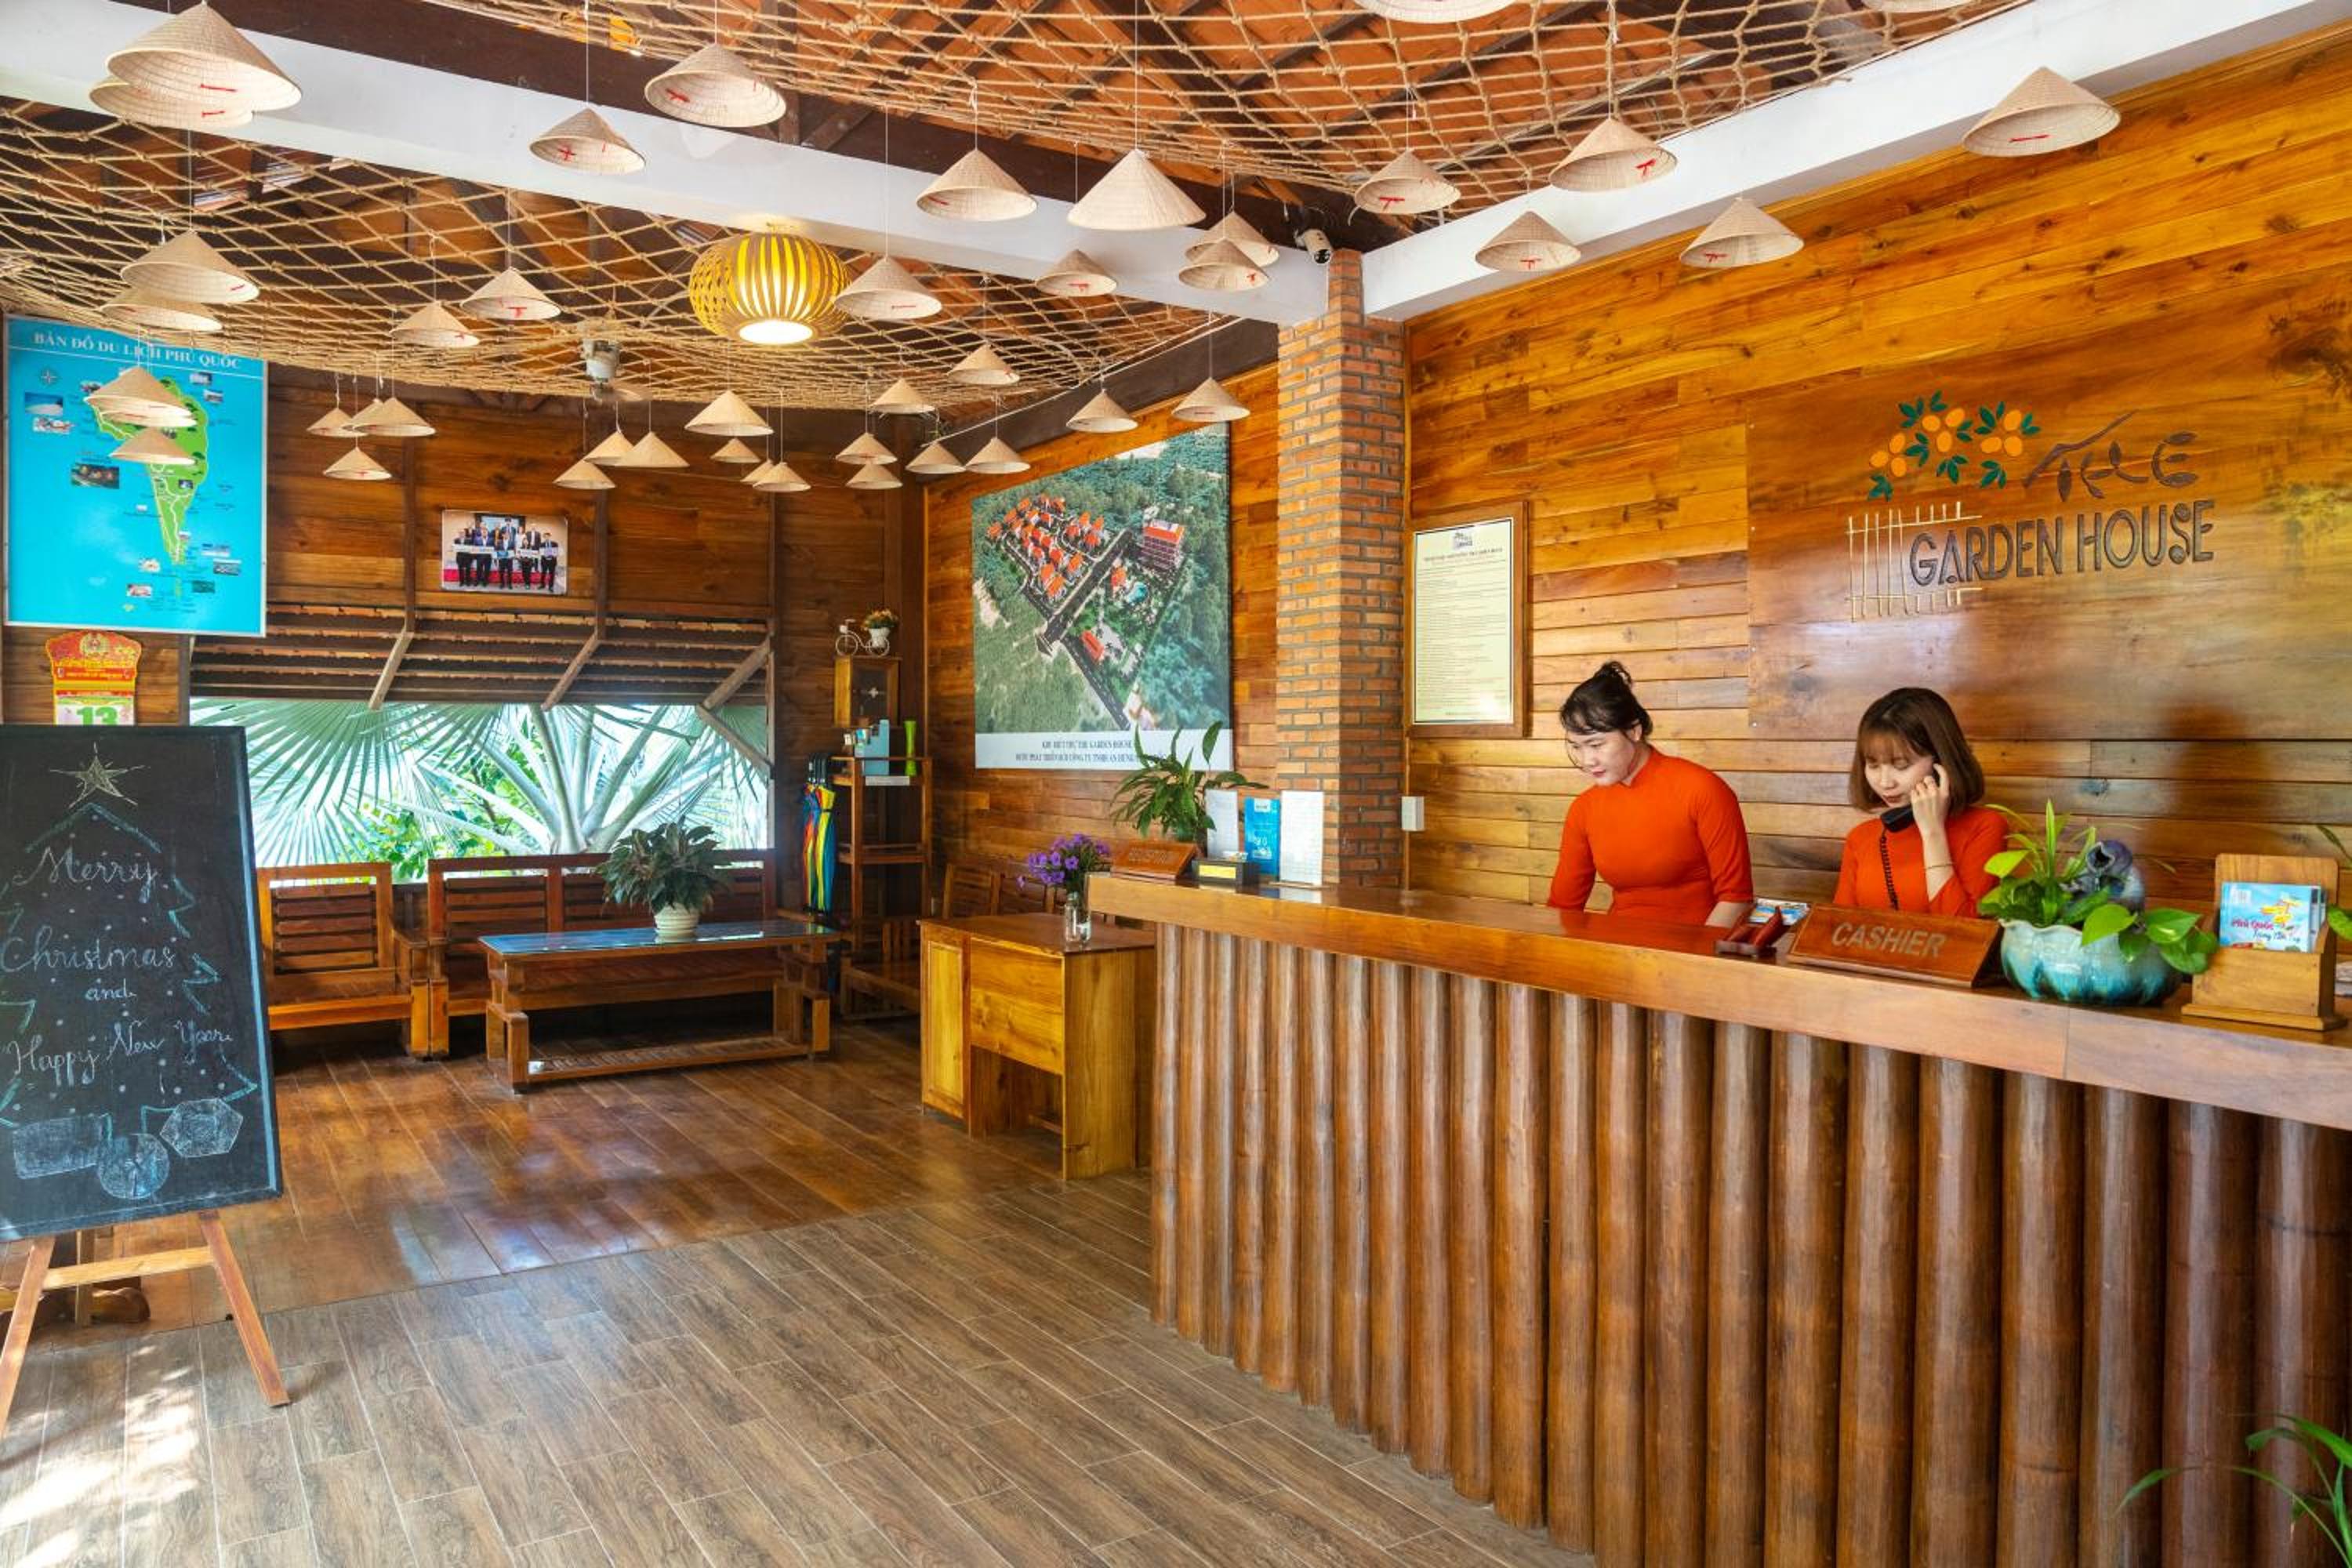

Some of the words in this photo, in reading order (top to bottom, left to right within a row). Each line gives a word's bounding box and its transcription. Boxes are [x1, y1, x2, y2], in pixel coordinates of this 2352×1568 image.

[1909, 514, 2063, 587] GARDEN
[2077, 499, 2215, 573] HOUSE
[12, 847, 159, 903] Merry
[1, 924, 176, 972] Christmas
[1831, 921, 1947, 958] CASHIER
[84, 978, 137, 1001] and
[2, 1034, 103, 1087] Happy
[106, 1018, 165, 1060] New
